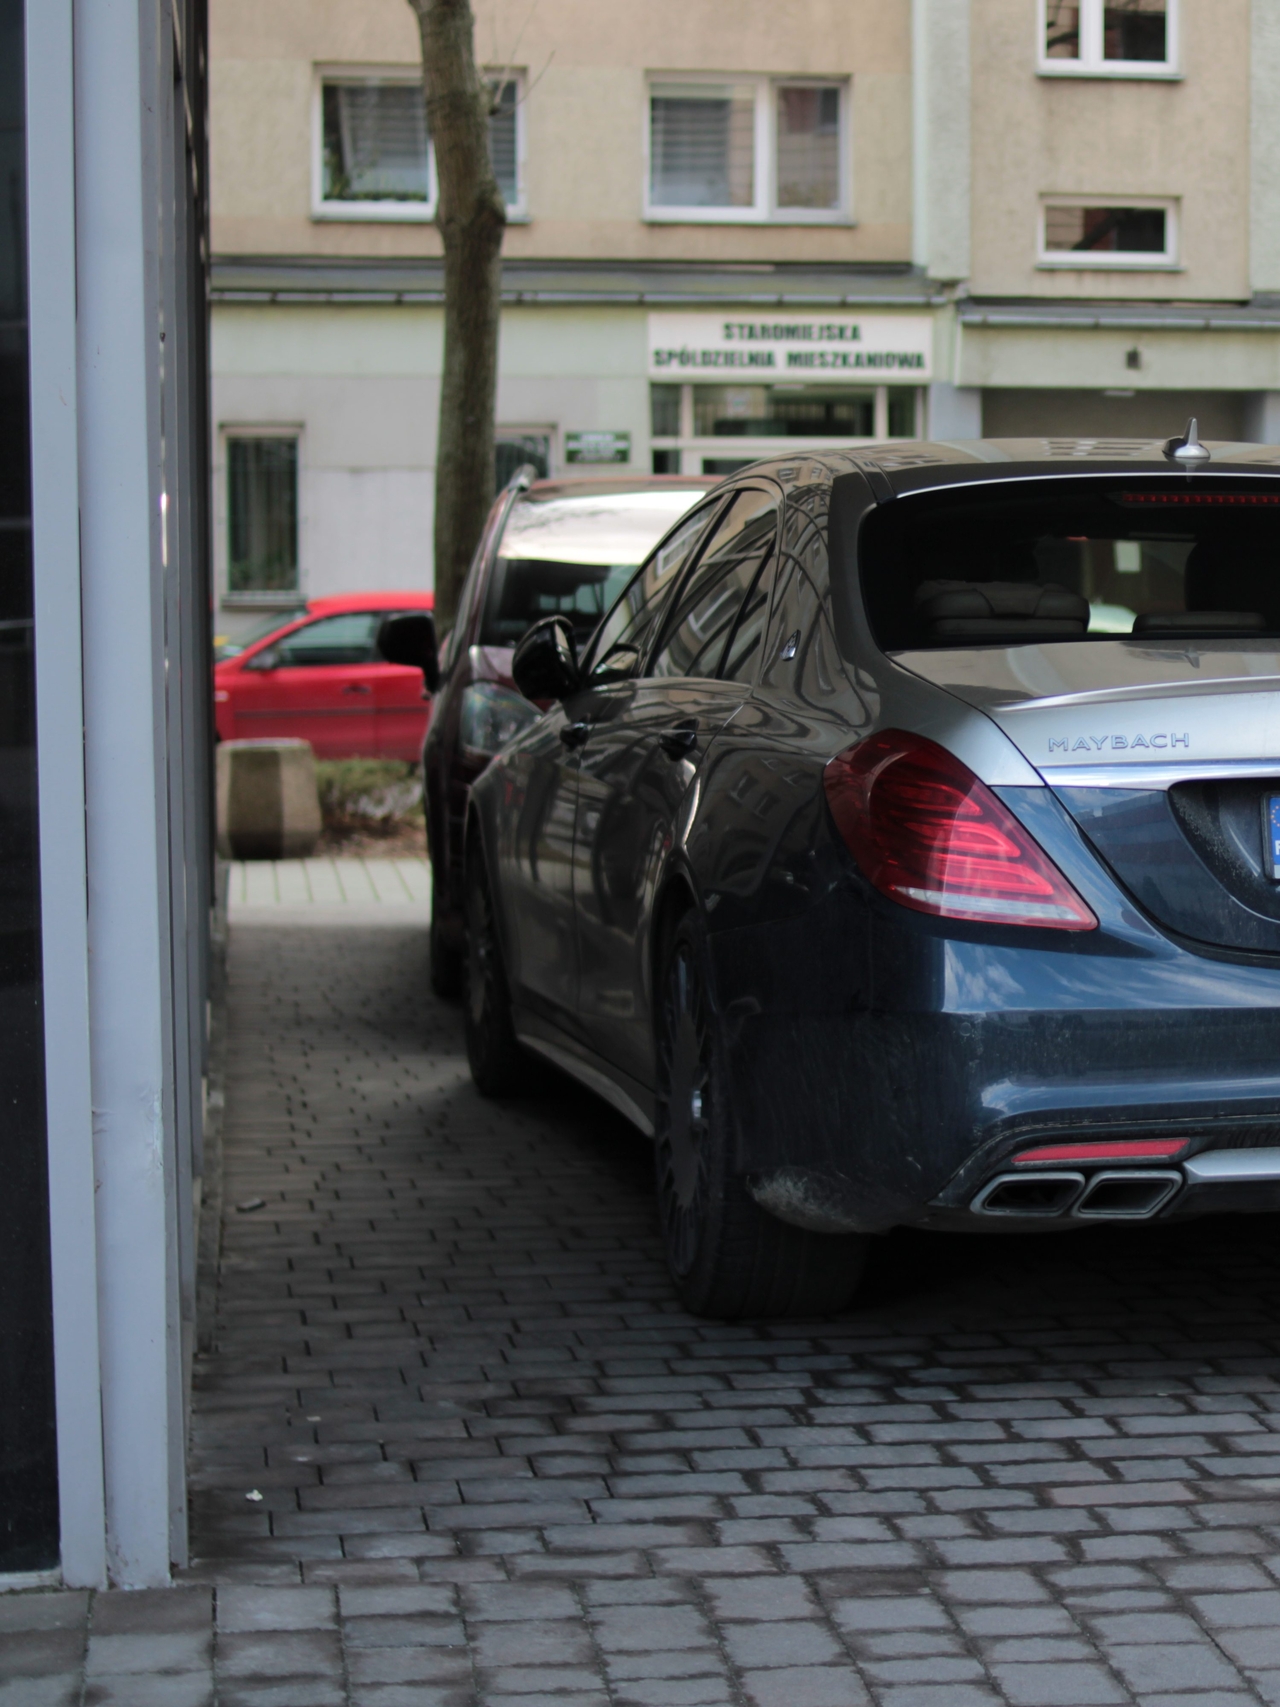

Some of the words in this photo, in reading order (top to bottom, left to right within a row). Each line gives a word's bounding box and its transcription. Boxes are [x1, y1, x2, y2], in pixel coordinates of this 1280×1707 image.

[723, 322, 861, 342] STAROMIEJSKA
[786, 350, 926, 369] MIESZKANIOWA
[1048, 732, 1190, 752] MAYBACH
